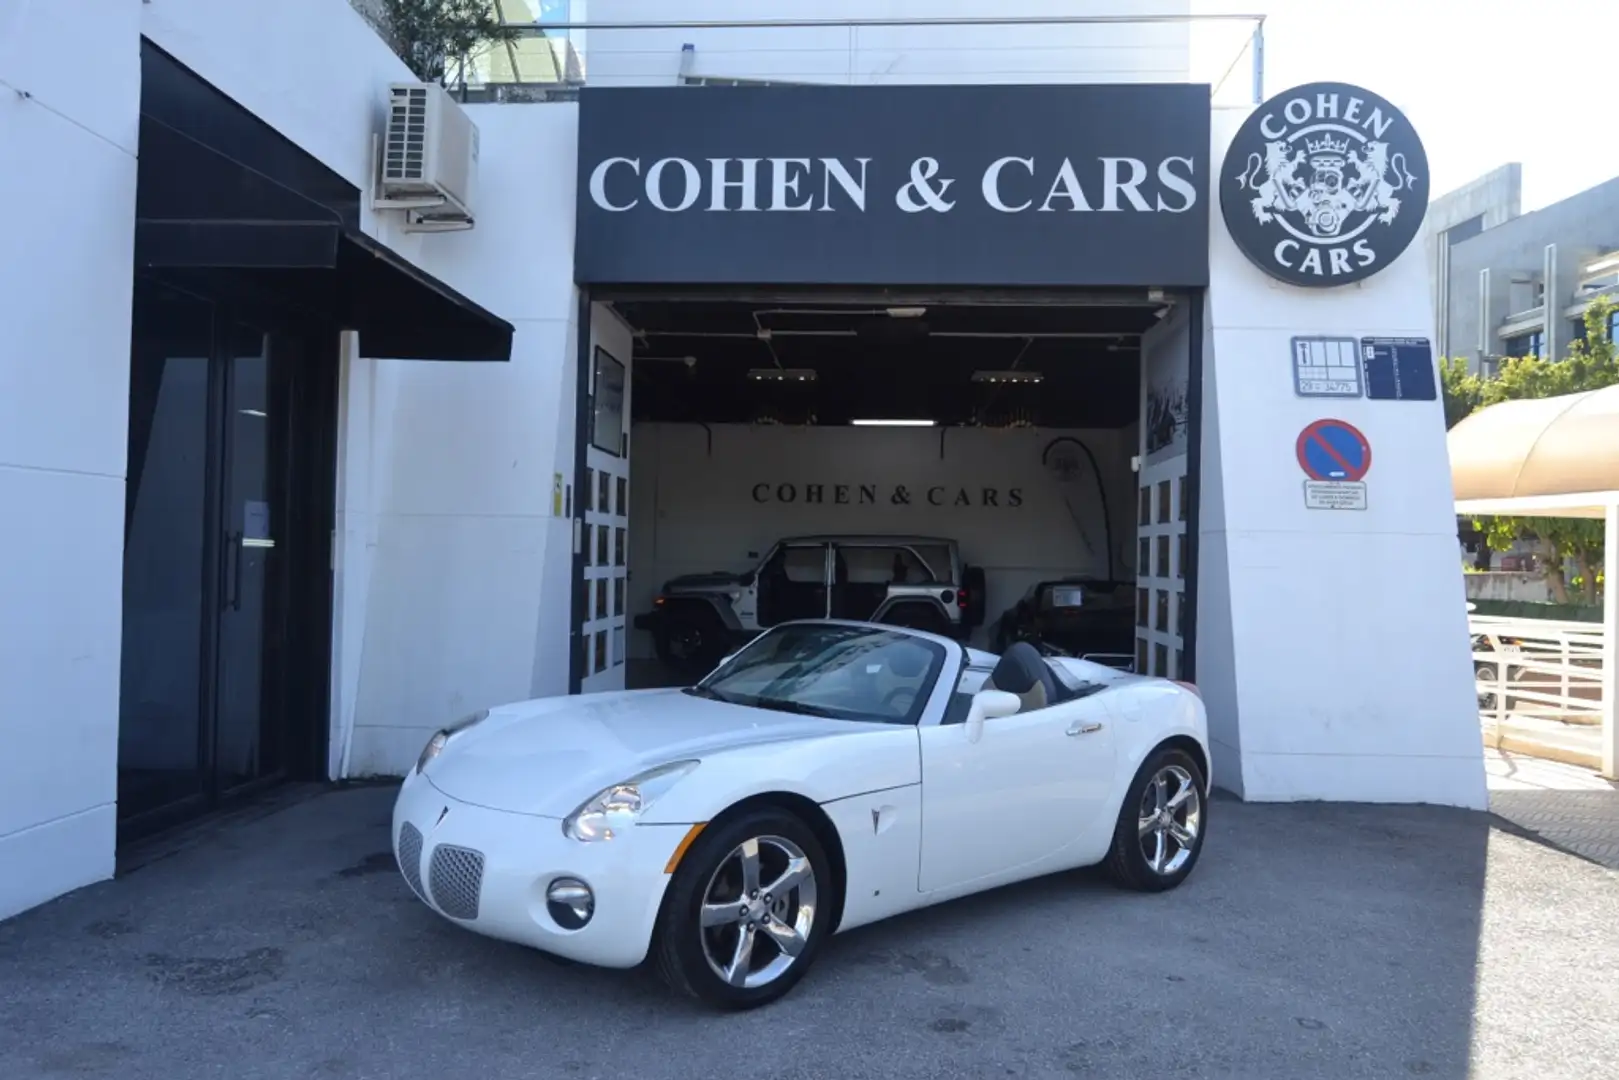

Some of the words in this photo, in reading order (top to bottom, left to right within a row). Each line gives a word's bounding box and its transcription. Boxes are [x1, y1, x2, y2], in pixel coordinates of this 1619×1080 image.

[1260, 93, 1394, 140] COHEN
[588, 157, 872, 212] COHEN
[895, 157, 956, 213] &
[981, 156, 1197, 213] CARS
[1274, 238, 1376, 276] CARS
[751, 482, 877, 505] COHEN
[890, 484, 911, 506] &
[926, 486, 1023, 508] CARS
